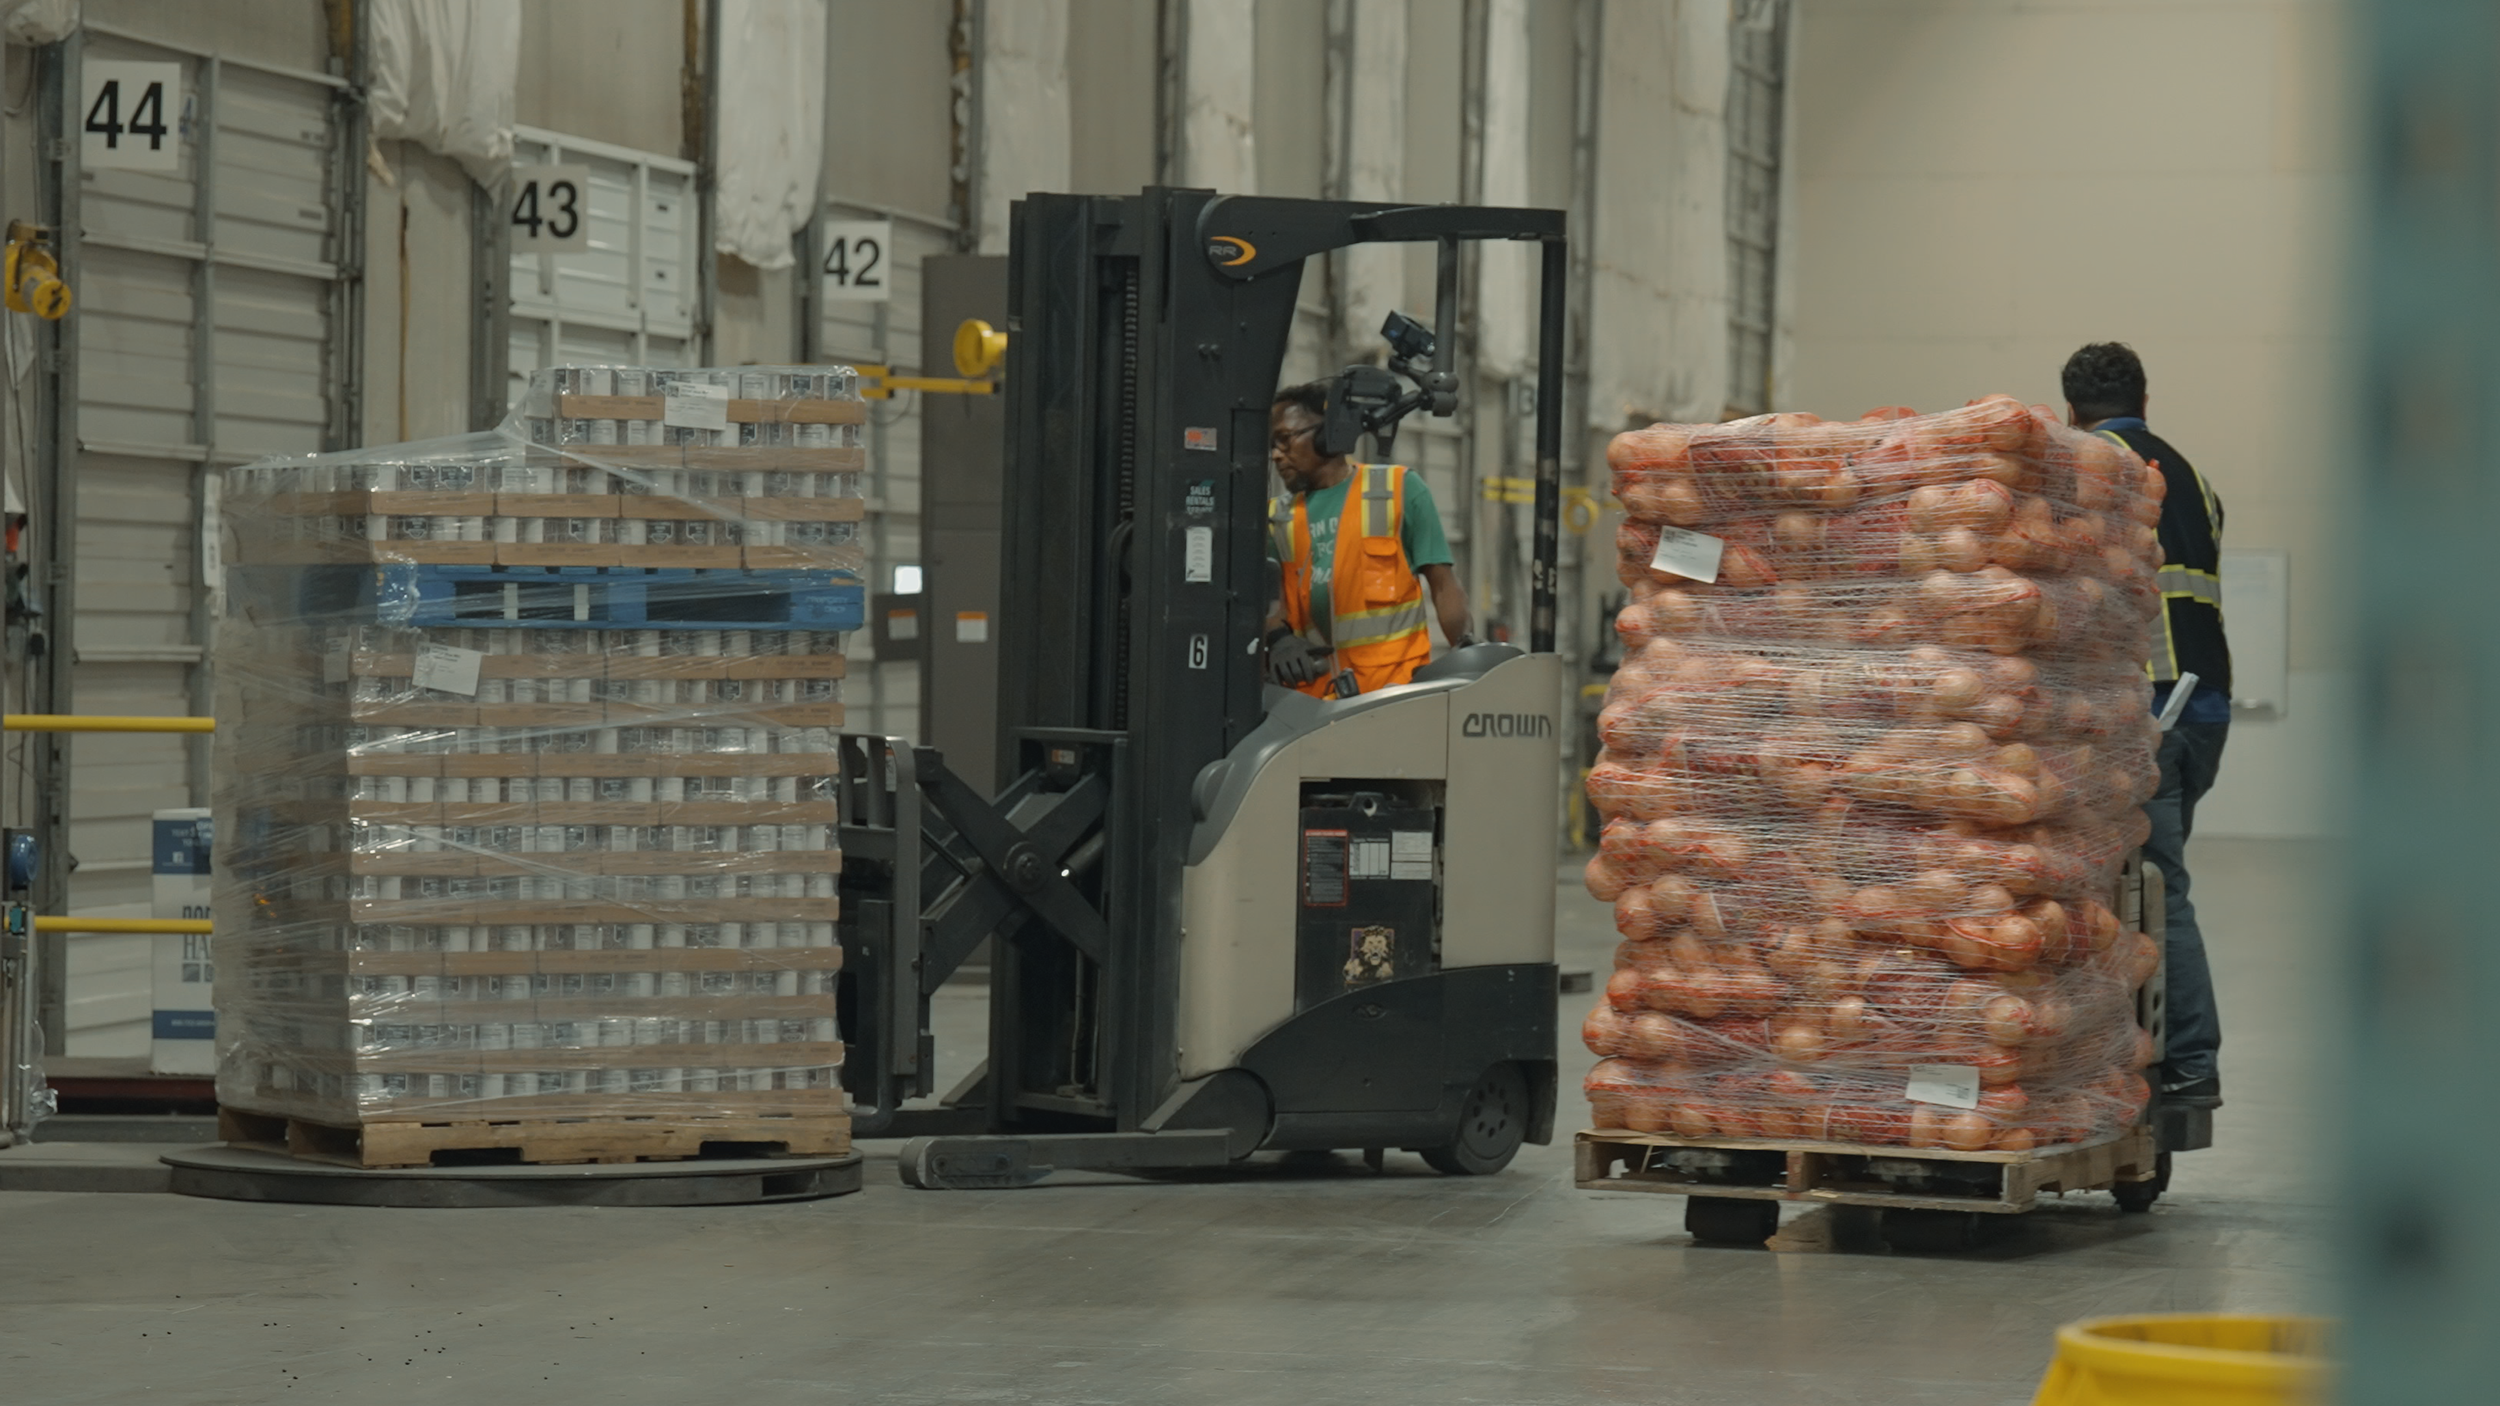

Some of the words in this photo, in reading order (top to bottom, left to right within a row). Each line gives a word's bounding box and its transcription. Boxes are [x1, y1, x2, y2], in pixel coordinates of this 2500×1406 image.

[85, 80, 168, 151] 44
[511, 181, 579, 238] 43
[823, 237, 881, 286] 42
[1209, 245, 1237, 256] RR
[1185, 495, 1215, 506] RENTALS
[1190, 485, 1211, 495] SALES
[1193, 636, 1205, 667] 6
[1463, 713, 1552, 738] CROWN
